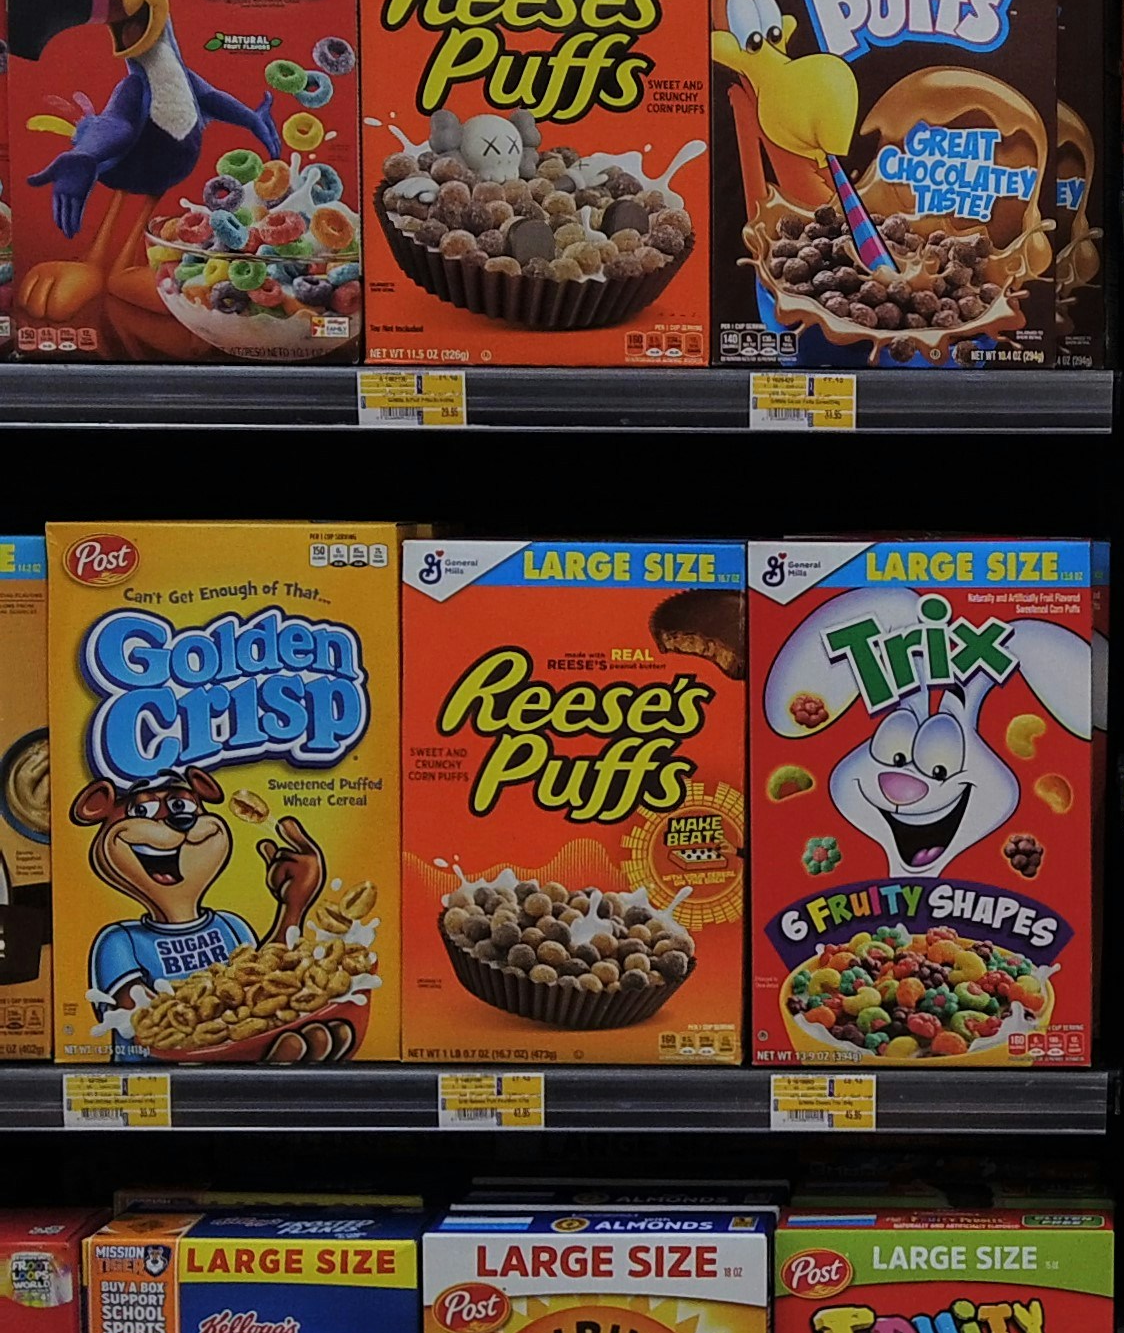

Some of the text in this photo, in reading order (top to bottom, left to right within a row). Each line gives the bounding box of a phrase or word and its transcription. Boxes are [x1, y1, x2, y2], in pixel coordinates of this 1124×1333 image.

[421, 25, 650, 119] Puffs
[905, 125, 1000, 161] GREAT
[879, 147, 1038, 201] CHOCOLATEY
[913, 185, 995, 222] TASTE!
[75, 541, 128, 575] Post
[124, 587, 162, 604] Can't
[169, 589, 194, 604] Get
[200, 582, 260, 602] Enough
[262, 582, 278, 596] of
[100, 612, 358, 688] Golden
[827, 595, 1014, 708] Trix
[105, 674, 363, 778] Crisp
[780, 884, 1058, 946] 6 FRUITY SHAPES
[187, 1249, 396, 1273] LARGE SIZE
[101, 1307, 166, 1321] SCHOOL
